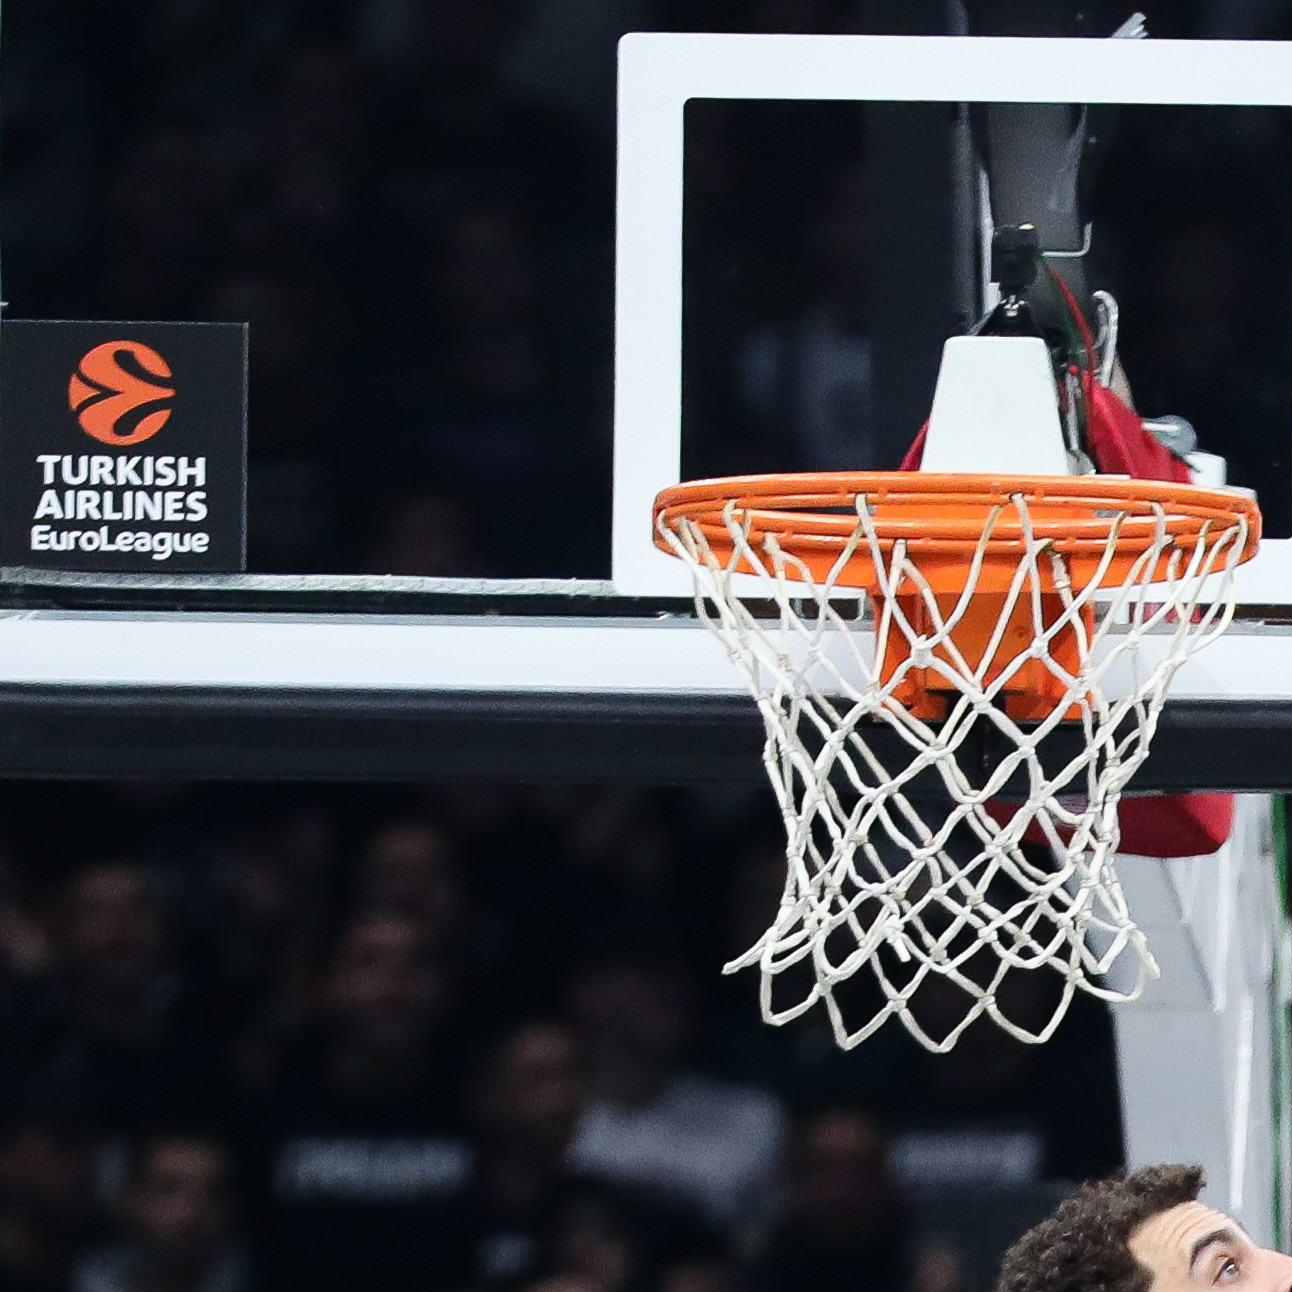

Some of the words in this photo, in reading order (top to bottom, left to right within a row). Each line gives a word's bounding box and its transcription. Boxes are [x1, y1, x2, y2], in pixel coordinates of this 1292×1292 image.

[35, 454, 207, 487] TURKISH
[33, 489, 208, 522] AIRLINES
[30, 524, 211, 561] EuroLeague
